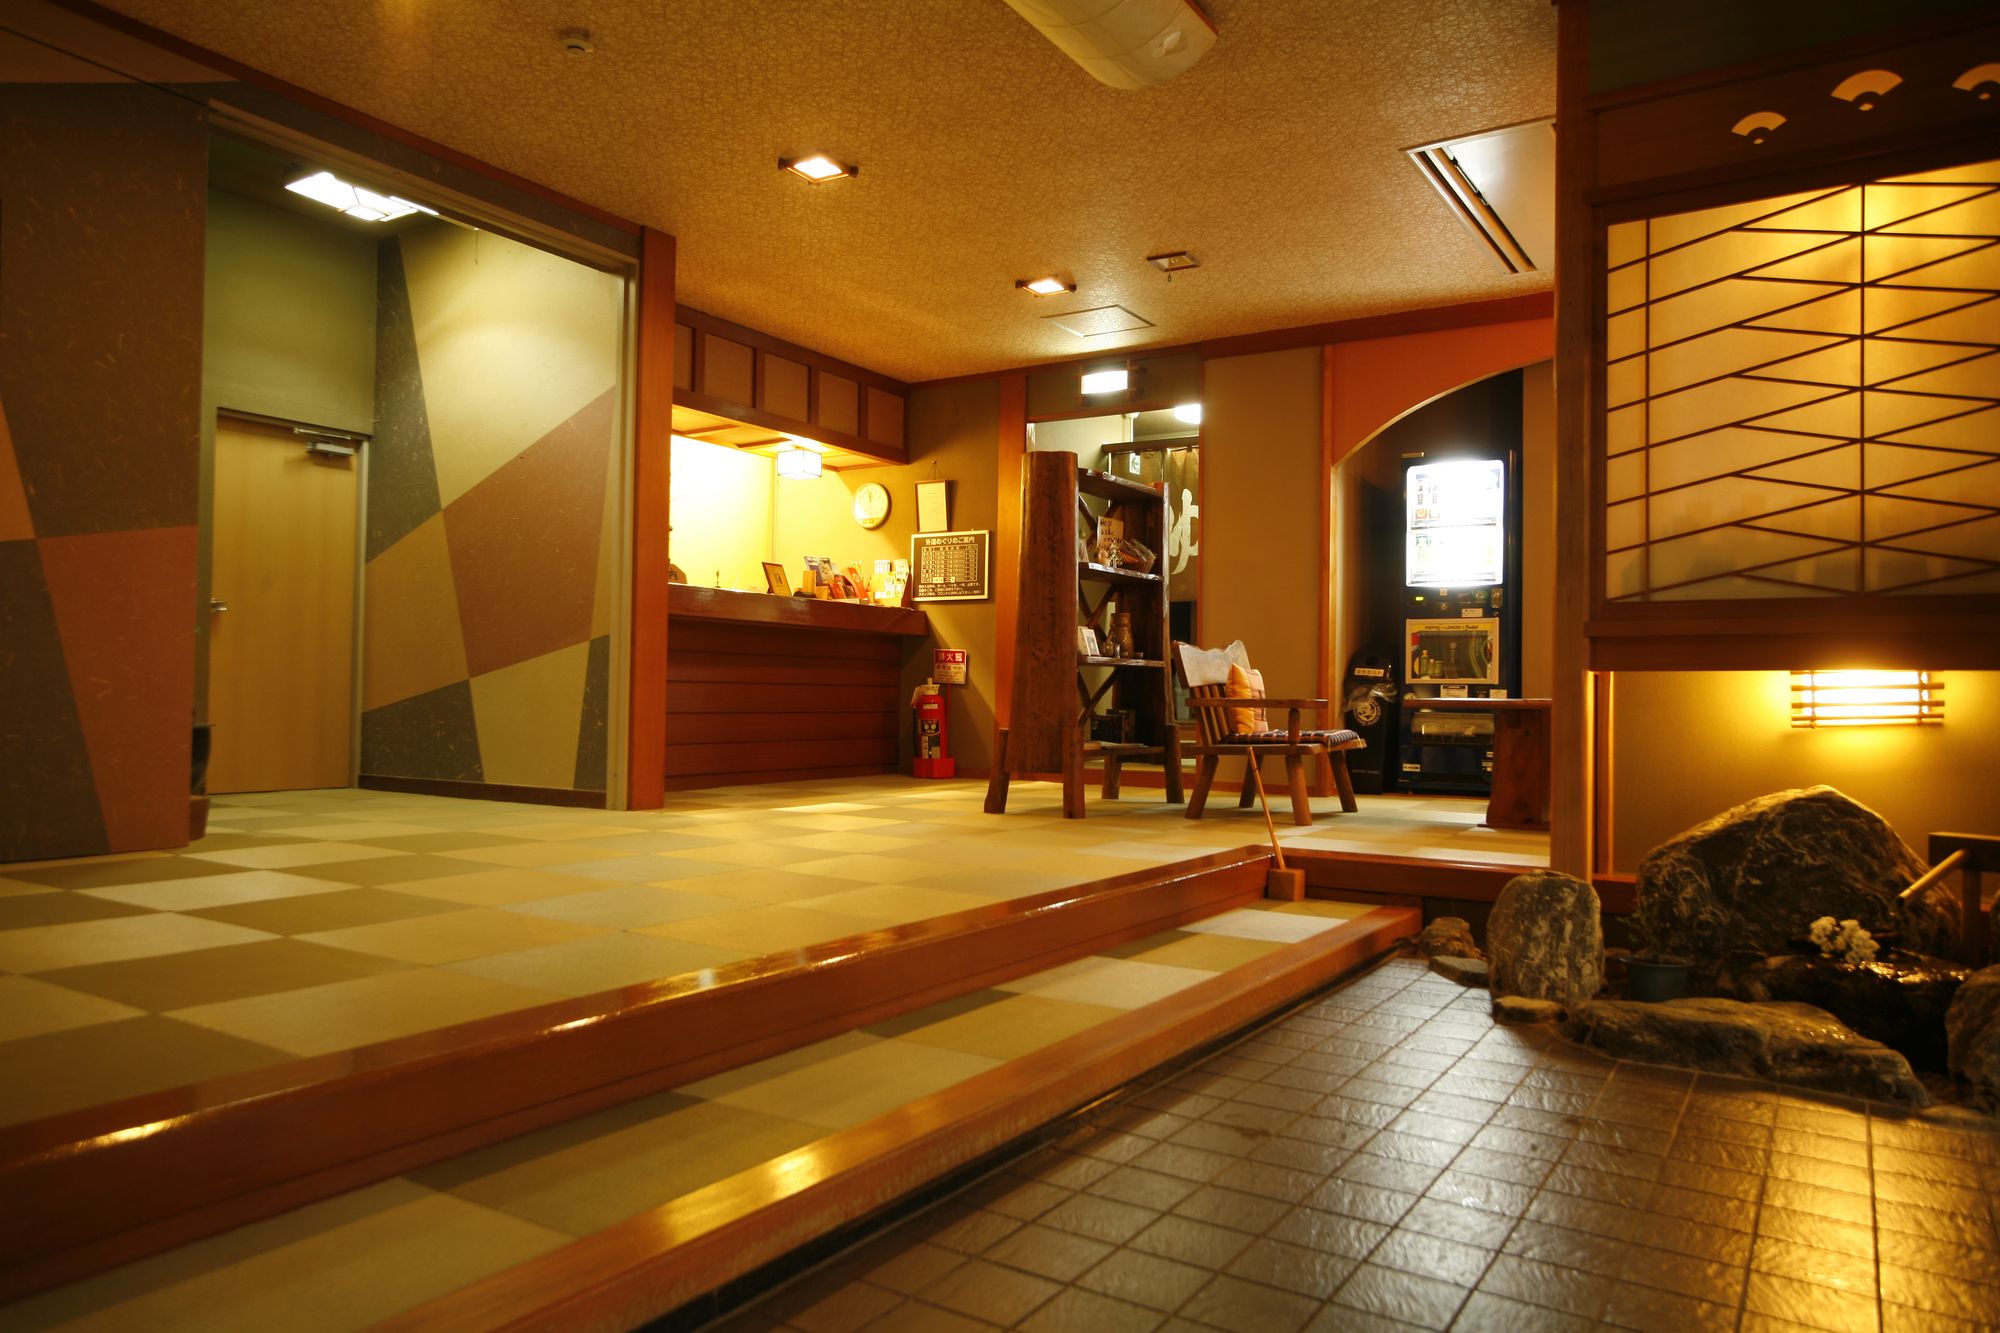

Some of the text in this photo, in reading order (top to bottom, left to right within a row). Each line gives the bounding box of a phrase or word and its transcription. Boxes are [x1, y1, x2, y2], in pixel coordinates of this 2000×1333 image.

[925, 536, 975, 545] 外湯めぐりのご案内
[937, 652, 963, 662] 消火器
